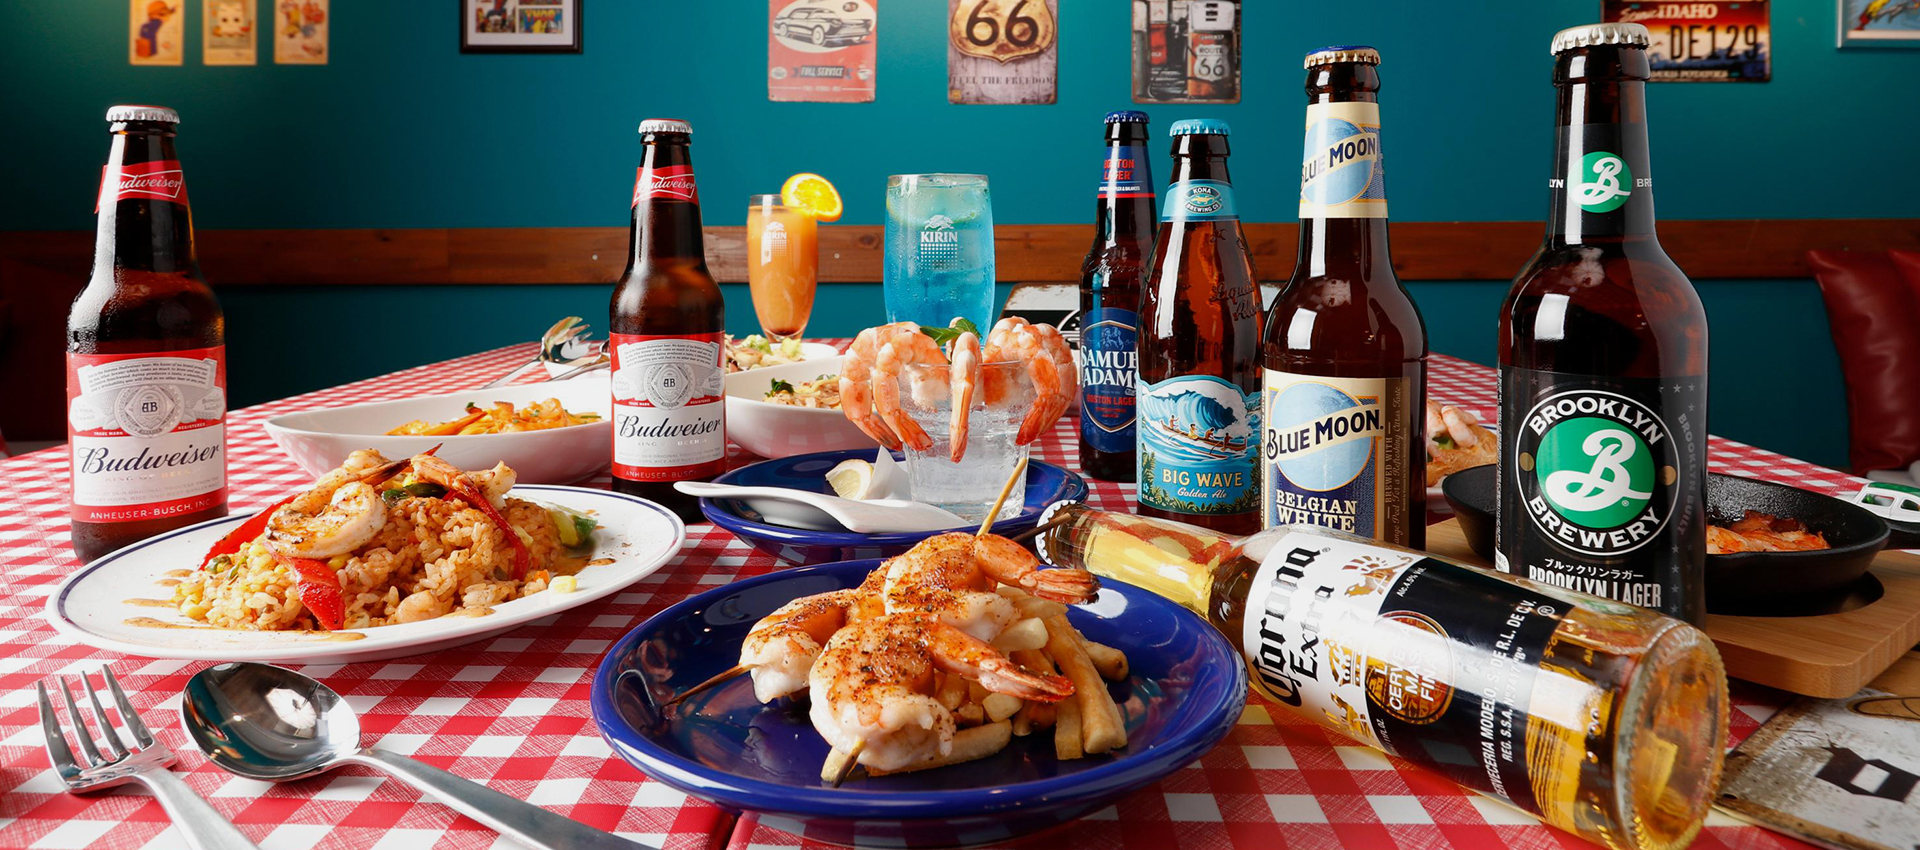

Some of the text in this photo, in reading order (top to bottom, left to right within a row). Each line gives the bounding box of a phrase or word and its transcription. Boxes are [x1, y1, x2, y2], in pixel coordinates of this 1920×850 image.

[1657, 4, 1719, 19] IDAHO
[966, 0, 1039, 47] 66
[1670, 25, 1758, 60] DE129
[801, 66, 844, 77] FULL SERVICE
[1198, 58, 1225, 76] 66
[982, 76, 1002, 84] THE
[1005, 76, 1054, 85] FREEDOM
[1302, 137, 1376, 184] LUE MOON
[117, 175, 182, 190] udweiser
[650, 177, 695, 190] udweiser
[1193, 186, 1213, 194] KONA
[921, 231, 958, 243] KIRIN
[1081, 345, 1137, 369] SAMUE
[663, 379, 676, 388] AB
[142, 402, 158, 413] AB
[1086, 394, 1112, 405] BOSTON
[617, 413, 721, 438] Budweiser
[1529, 396, 1664, 446] BROOKLYN
[78, 444, 220, 474] Budweiser
[1385, 437, 1393, 461] WITH
[1162, 468, 1244, 488] BIG WAVE
[1177, 486, 1228, 499] Golden Ale
[1276, 489, 1357, 515] BELGIAN
[1277, 504, 1355, 533] WHITE
[1529, 495, 1661, 549] BREWERY
[1393, 524, 1404, 544] ange
[1544, 558, 1644, 580] ブルックリンラガー
[1252, 547, 1321, 707] Corona
[1506, 613, 1525, 628] DE
[1289, 585, 1335, 683] Extra
[1388, 628, 1411, 711] CERVEA
